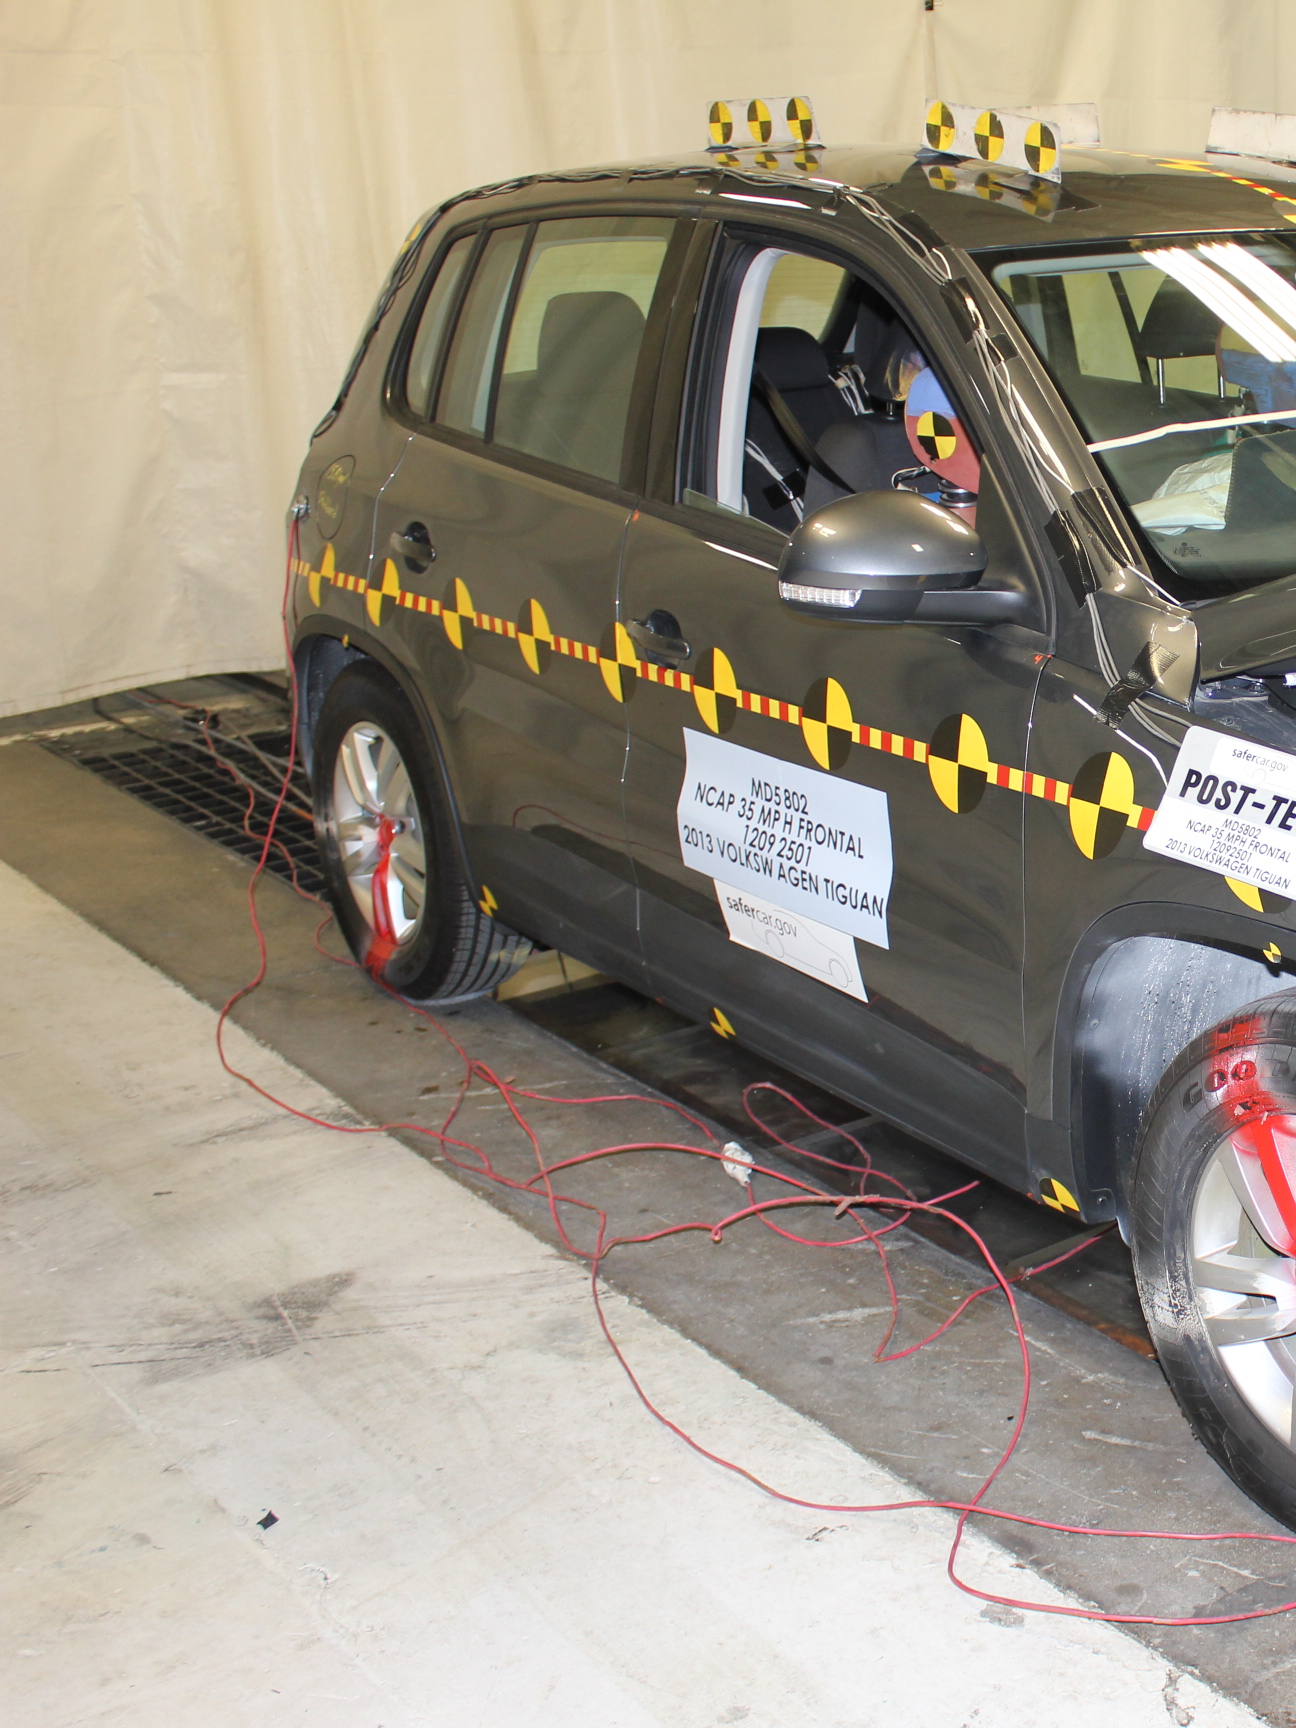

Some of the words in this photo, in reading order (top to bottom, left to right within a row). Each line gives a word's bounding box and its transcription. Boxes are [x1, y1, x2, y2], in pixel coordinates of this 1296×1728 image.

[1231, 747, 1290, 773] safercar.gov
[751, 777, 809, 816] MD5802
[694, 781, 736, 813] NCAP
[737, 797, 755, 822] 35
[757, 804, 793, 835] MPH
[797, 817, 864, 860] FRONTAL
[1186, 819, 1212, 836] NCAP
[1211, 826, 1226, 841] 35
[1224, 830, 1249, 848] MPH
[1248, 838, 1291, 863] FRONTAL
[1222, 818, 1261, 840] MD5802
[683, 824, 714, 854] 2013
[716, 836, 820, 896] VOLKSWAGEN
[823, 877, 885, 920] TIGUAN
[1165, 838, 1187, 854] 2013
[1187, 845, 1253, 877] VOLKSWAGEN
[1252, 864, 1291, 890] TIGUAN
[1209, 839, 1253, 863] 12092501
[726, 895, 798, 938] safercar.gov
